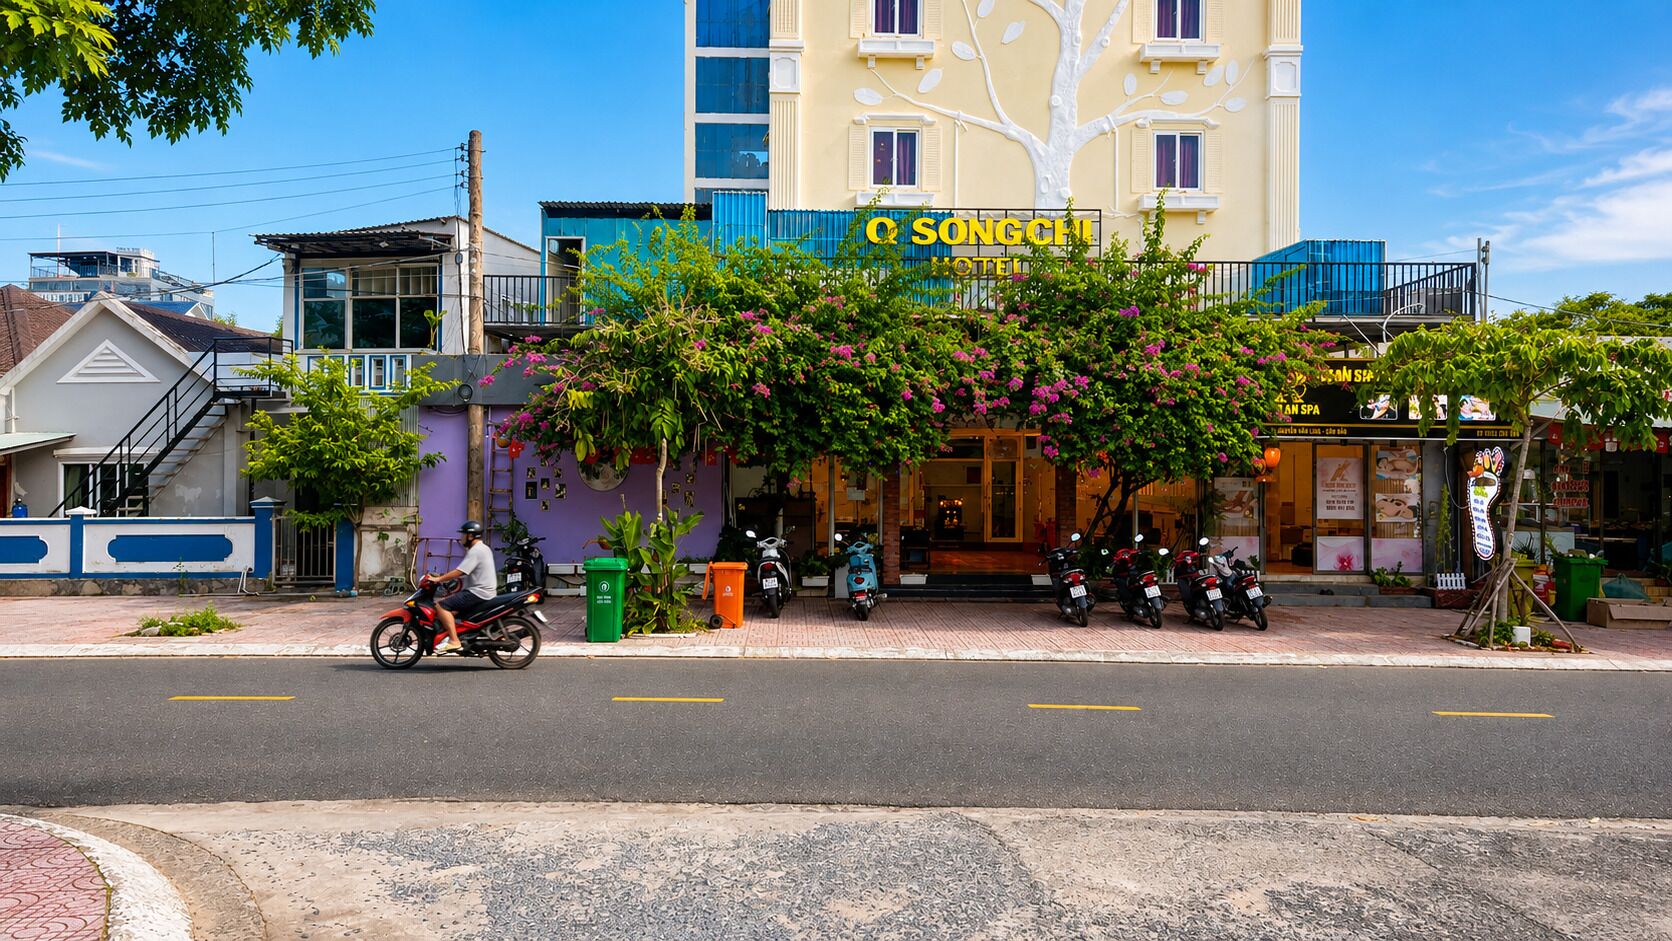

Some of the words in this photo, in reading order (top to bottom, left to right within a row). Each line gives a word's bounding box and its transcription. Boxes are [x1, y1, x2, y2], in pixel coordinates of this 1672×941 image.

[866, 216, 898, 245] Q
[911, 217, 1094, 246] SONGCHI
[931, 256, 1022, 276] HOTEL
[1300, 404, 1321, 415] SPA
